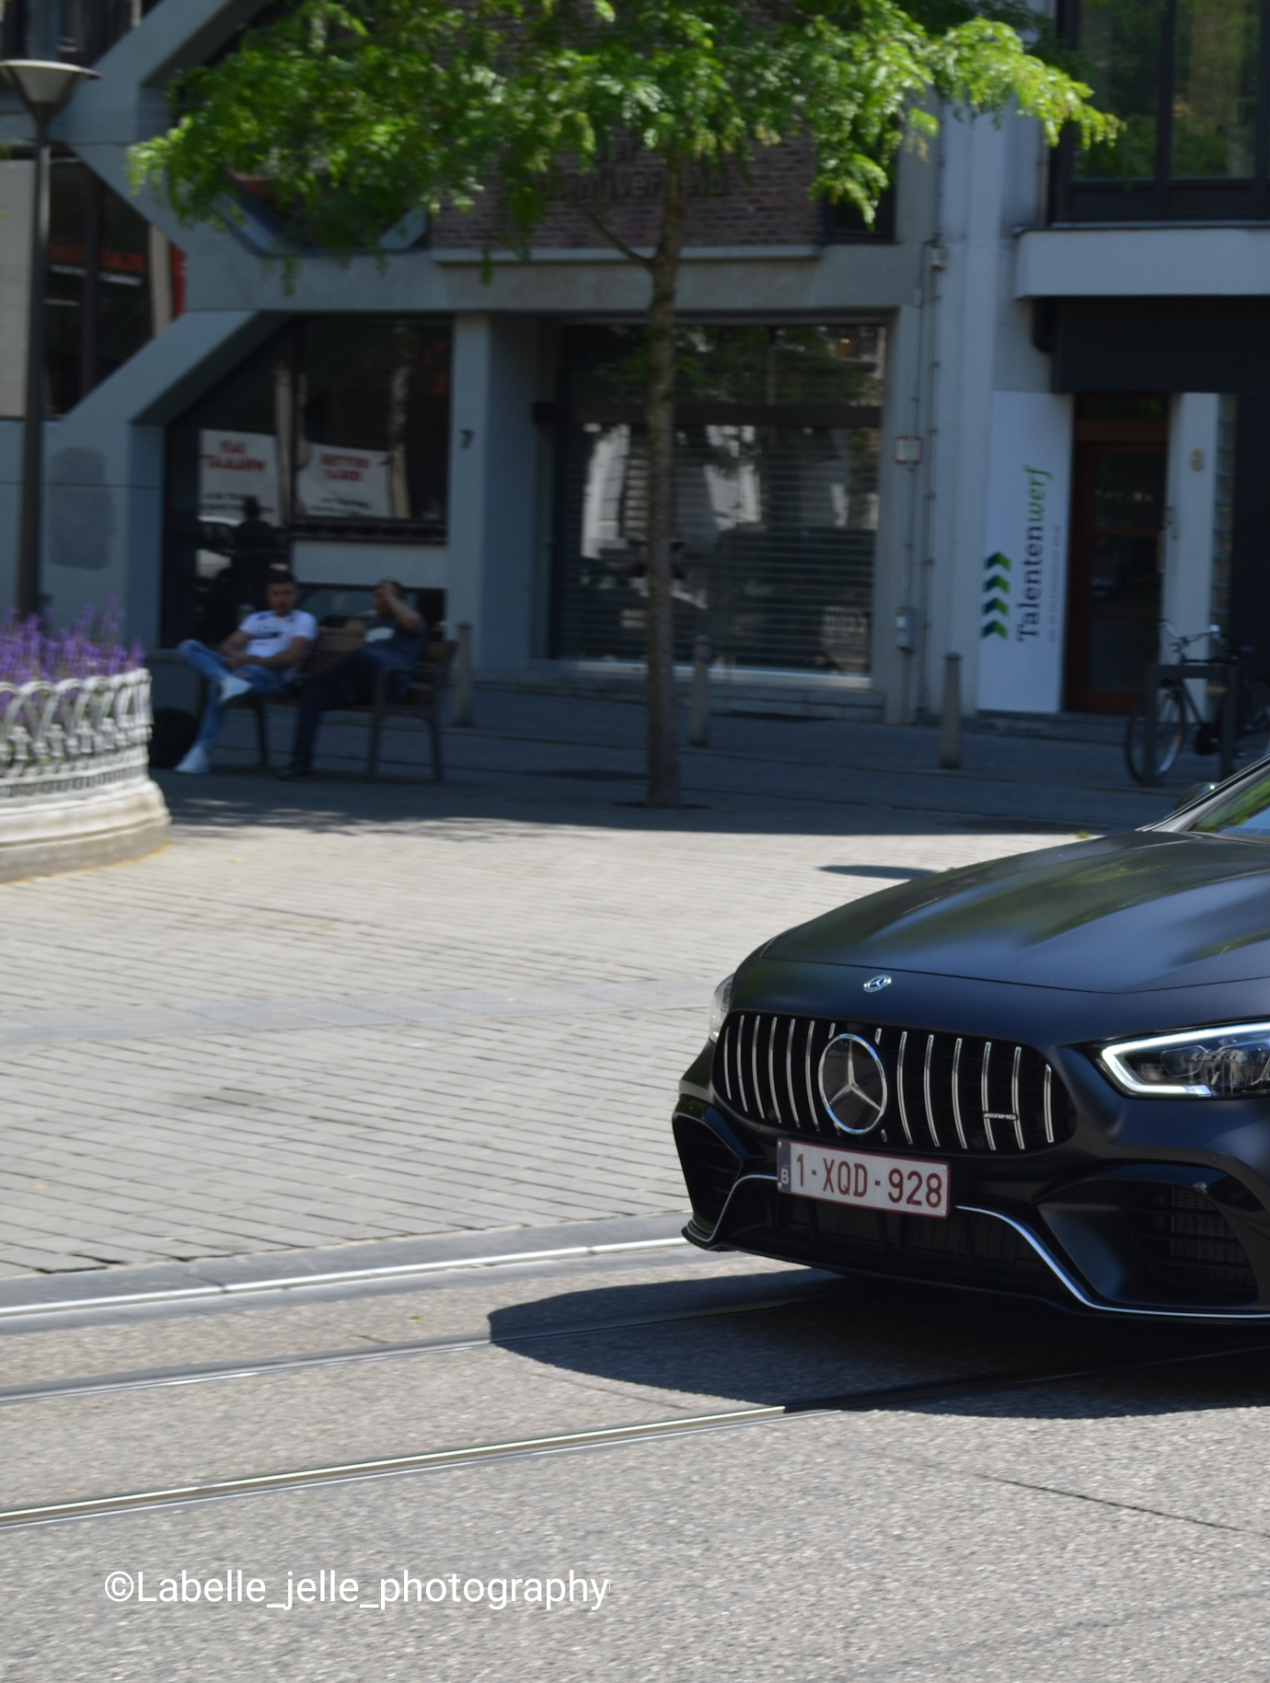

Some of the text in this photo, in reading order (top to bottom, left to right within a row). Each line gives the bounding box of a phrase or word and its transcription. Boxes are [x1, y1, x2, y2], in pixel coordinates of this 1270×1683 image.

[460, 428, 475, 450] 7
[1015, 463, 1054, 642] Talentenwerf
[780, 1153, 943, 1208] B 1-XQD-928
